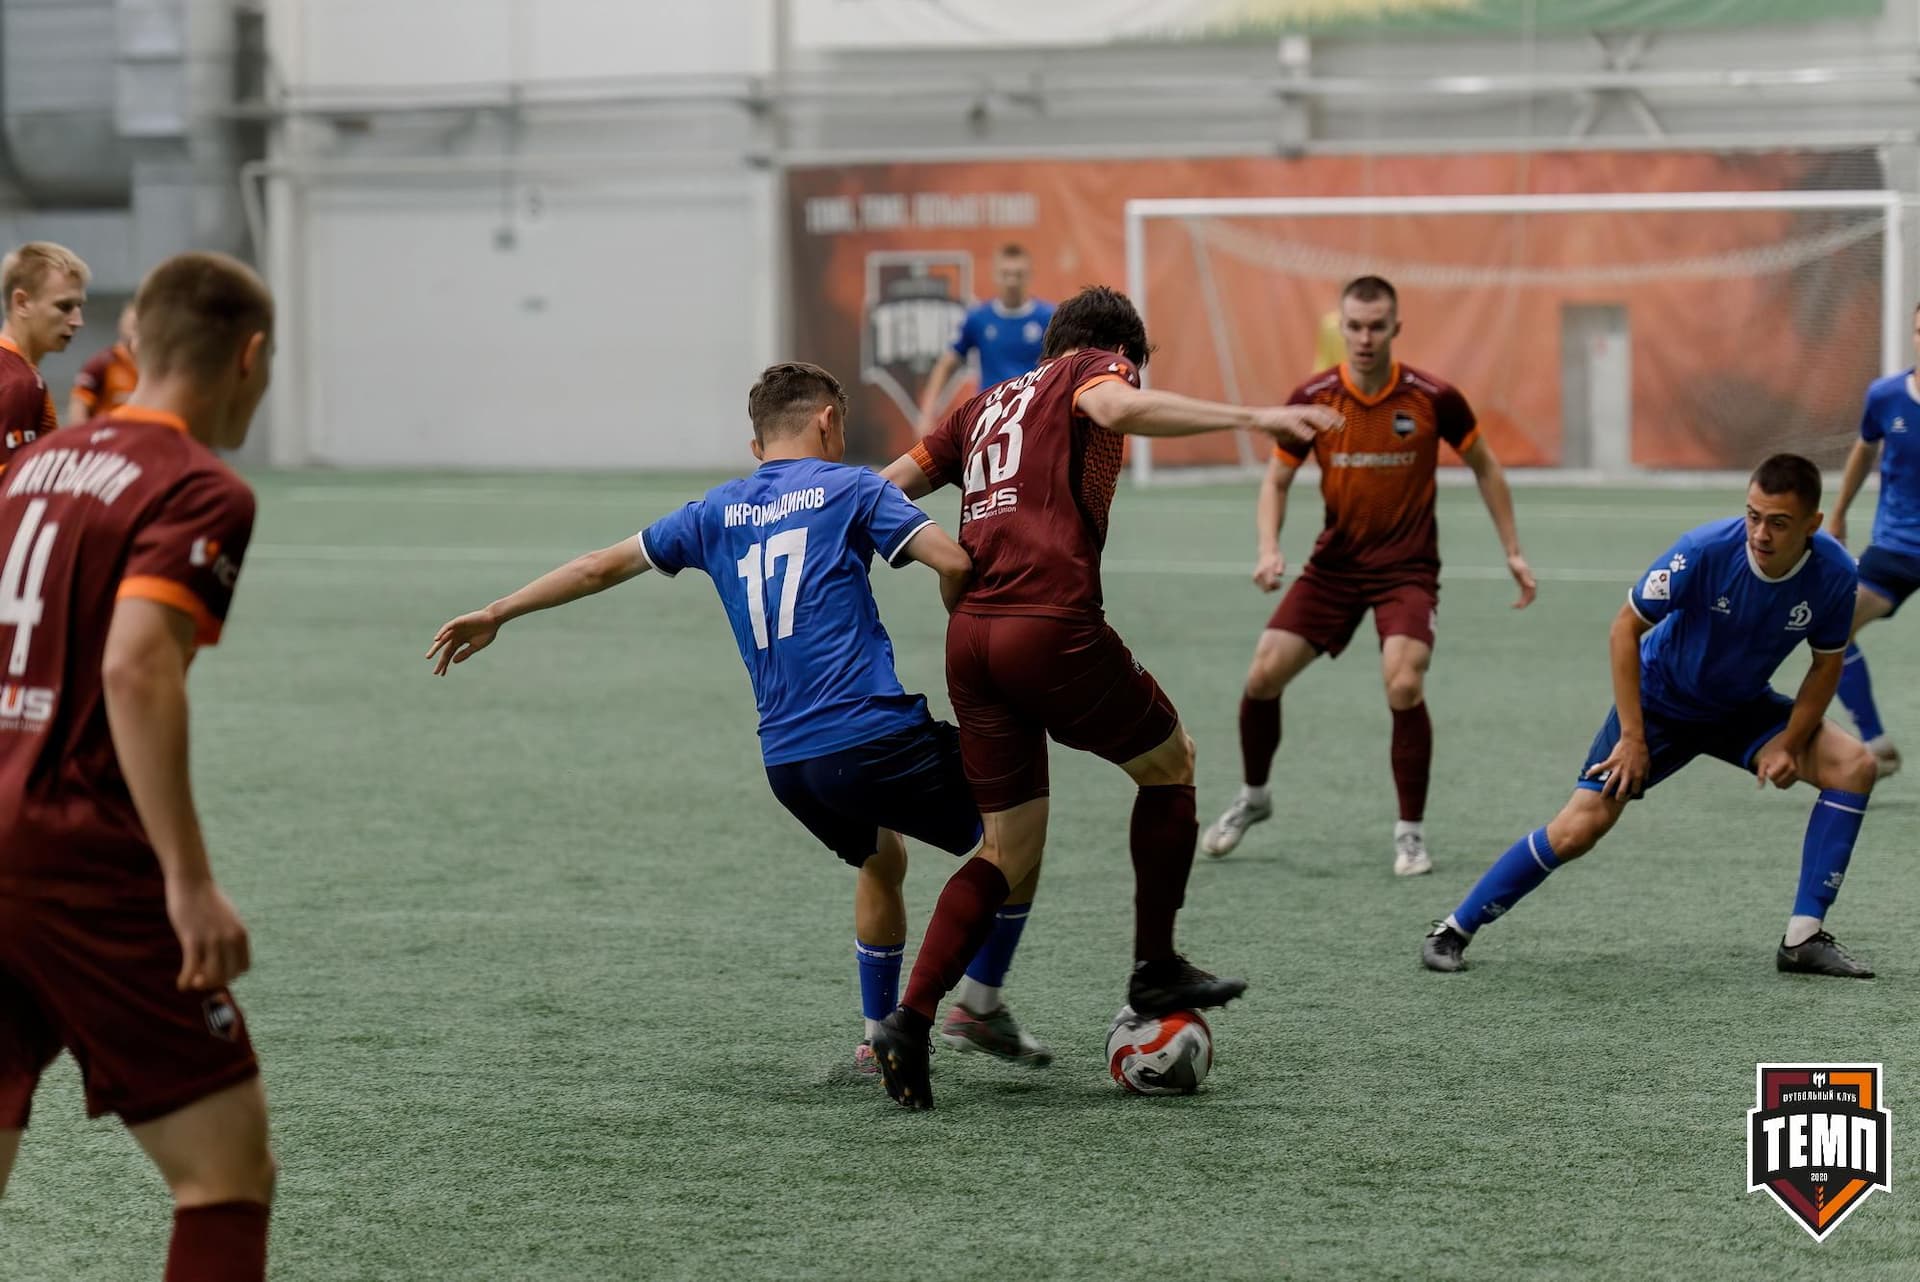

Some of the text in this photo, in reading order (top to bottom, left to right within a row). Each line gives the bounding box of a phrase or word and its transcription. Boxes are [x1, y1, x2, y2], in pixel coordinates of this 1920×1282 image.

[964, 386, 1035, 495] 23
[0, 499, 58, 676] 4
[737, 527, 808, 650] 17
[0, 687, 53, 720] US
